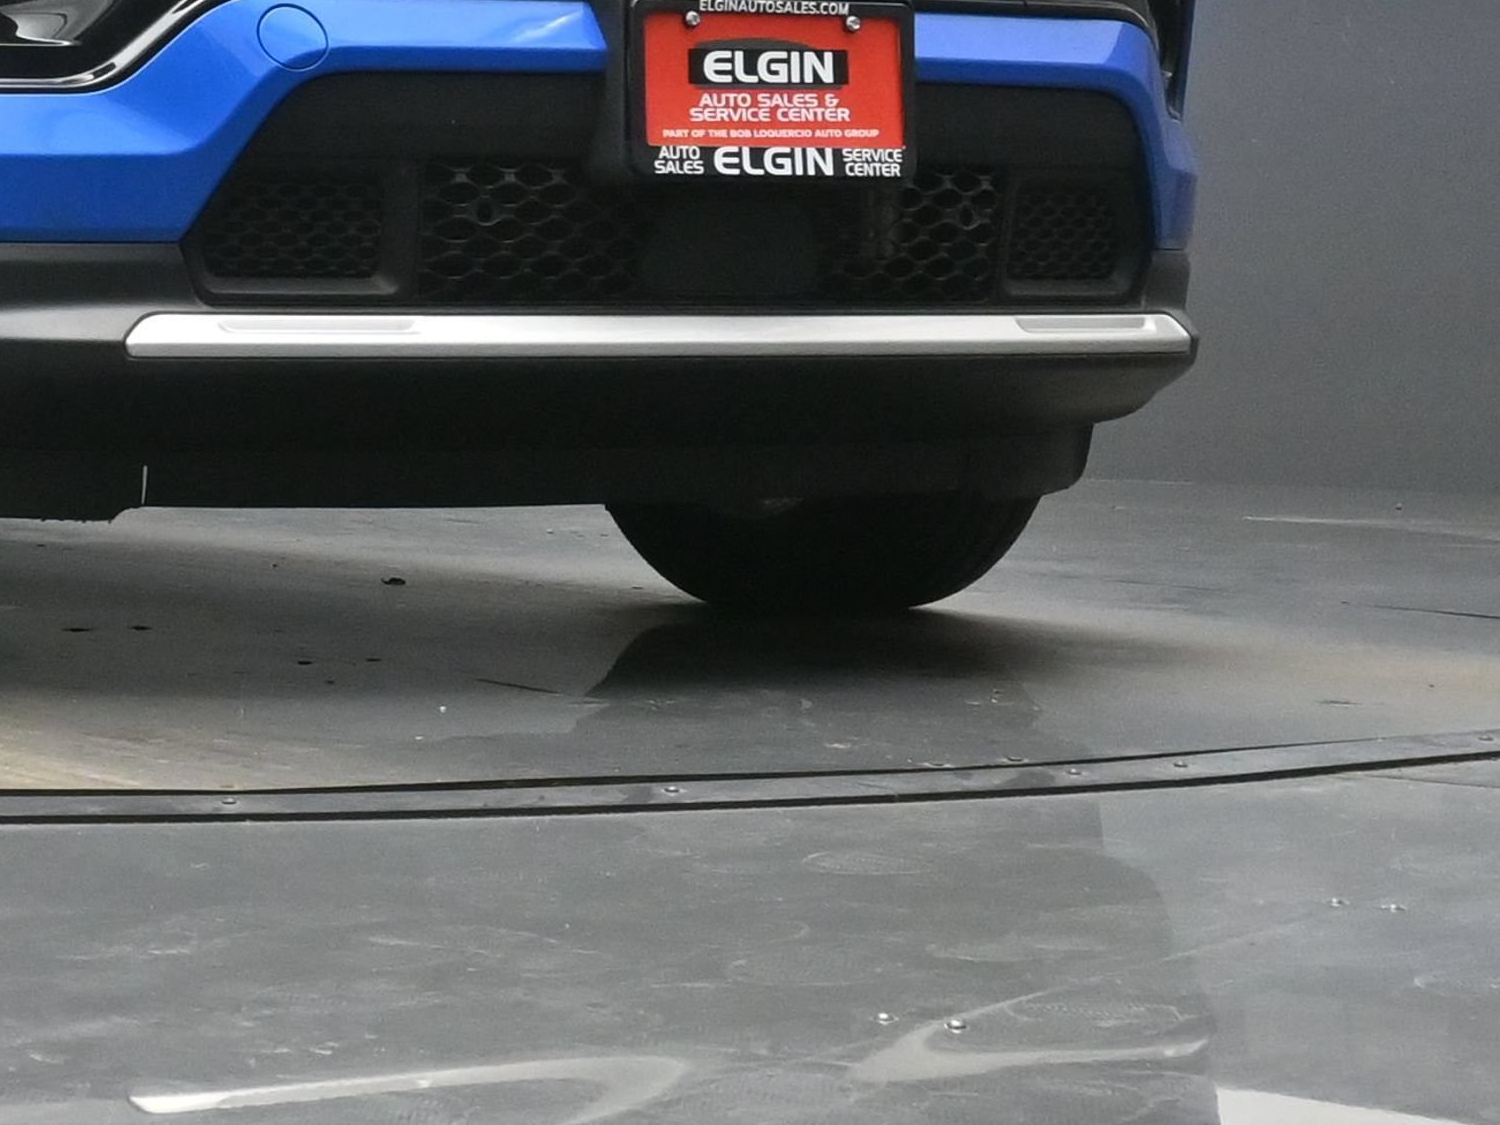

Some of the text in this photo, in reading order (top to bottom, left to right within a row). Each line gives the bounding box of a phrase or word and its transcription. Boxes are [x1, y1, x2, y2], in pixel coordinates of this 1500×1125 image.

[703, 50, 834, 83] ELGIN
[699, 93, 839, 107] AUTO SALES &
[689, 107, 850, 122] SERVICE CENTER
[663, 129, 879, 138] PART OF THE BOB LOQUERCIO AUTO GROUP
[658, 146, 700, 160] AUTO
[842, 149, 902, 163] SERVICE
[654, 160, 704, 174] SALES
[713, 146, 834, 176] ELGIN
[845, 162, 901, 177] CENTER
